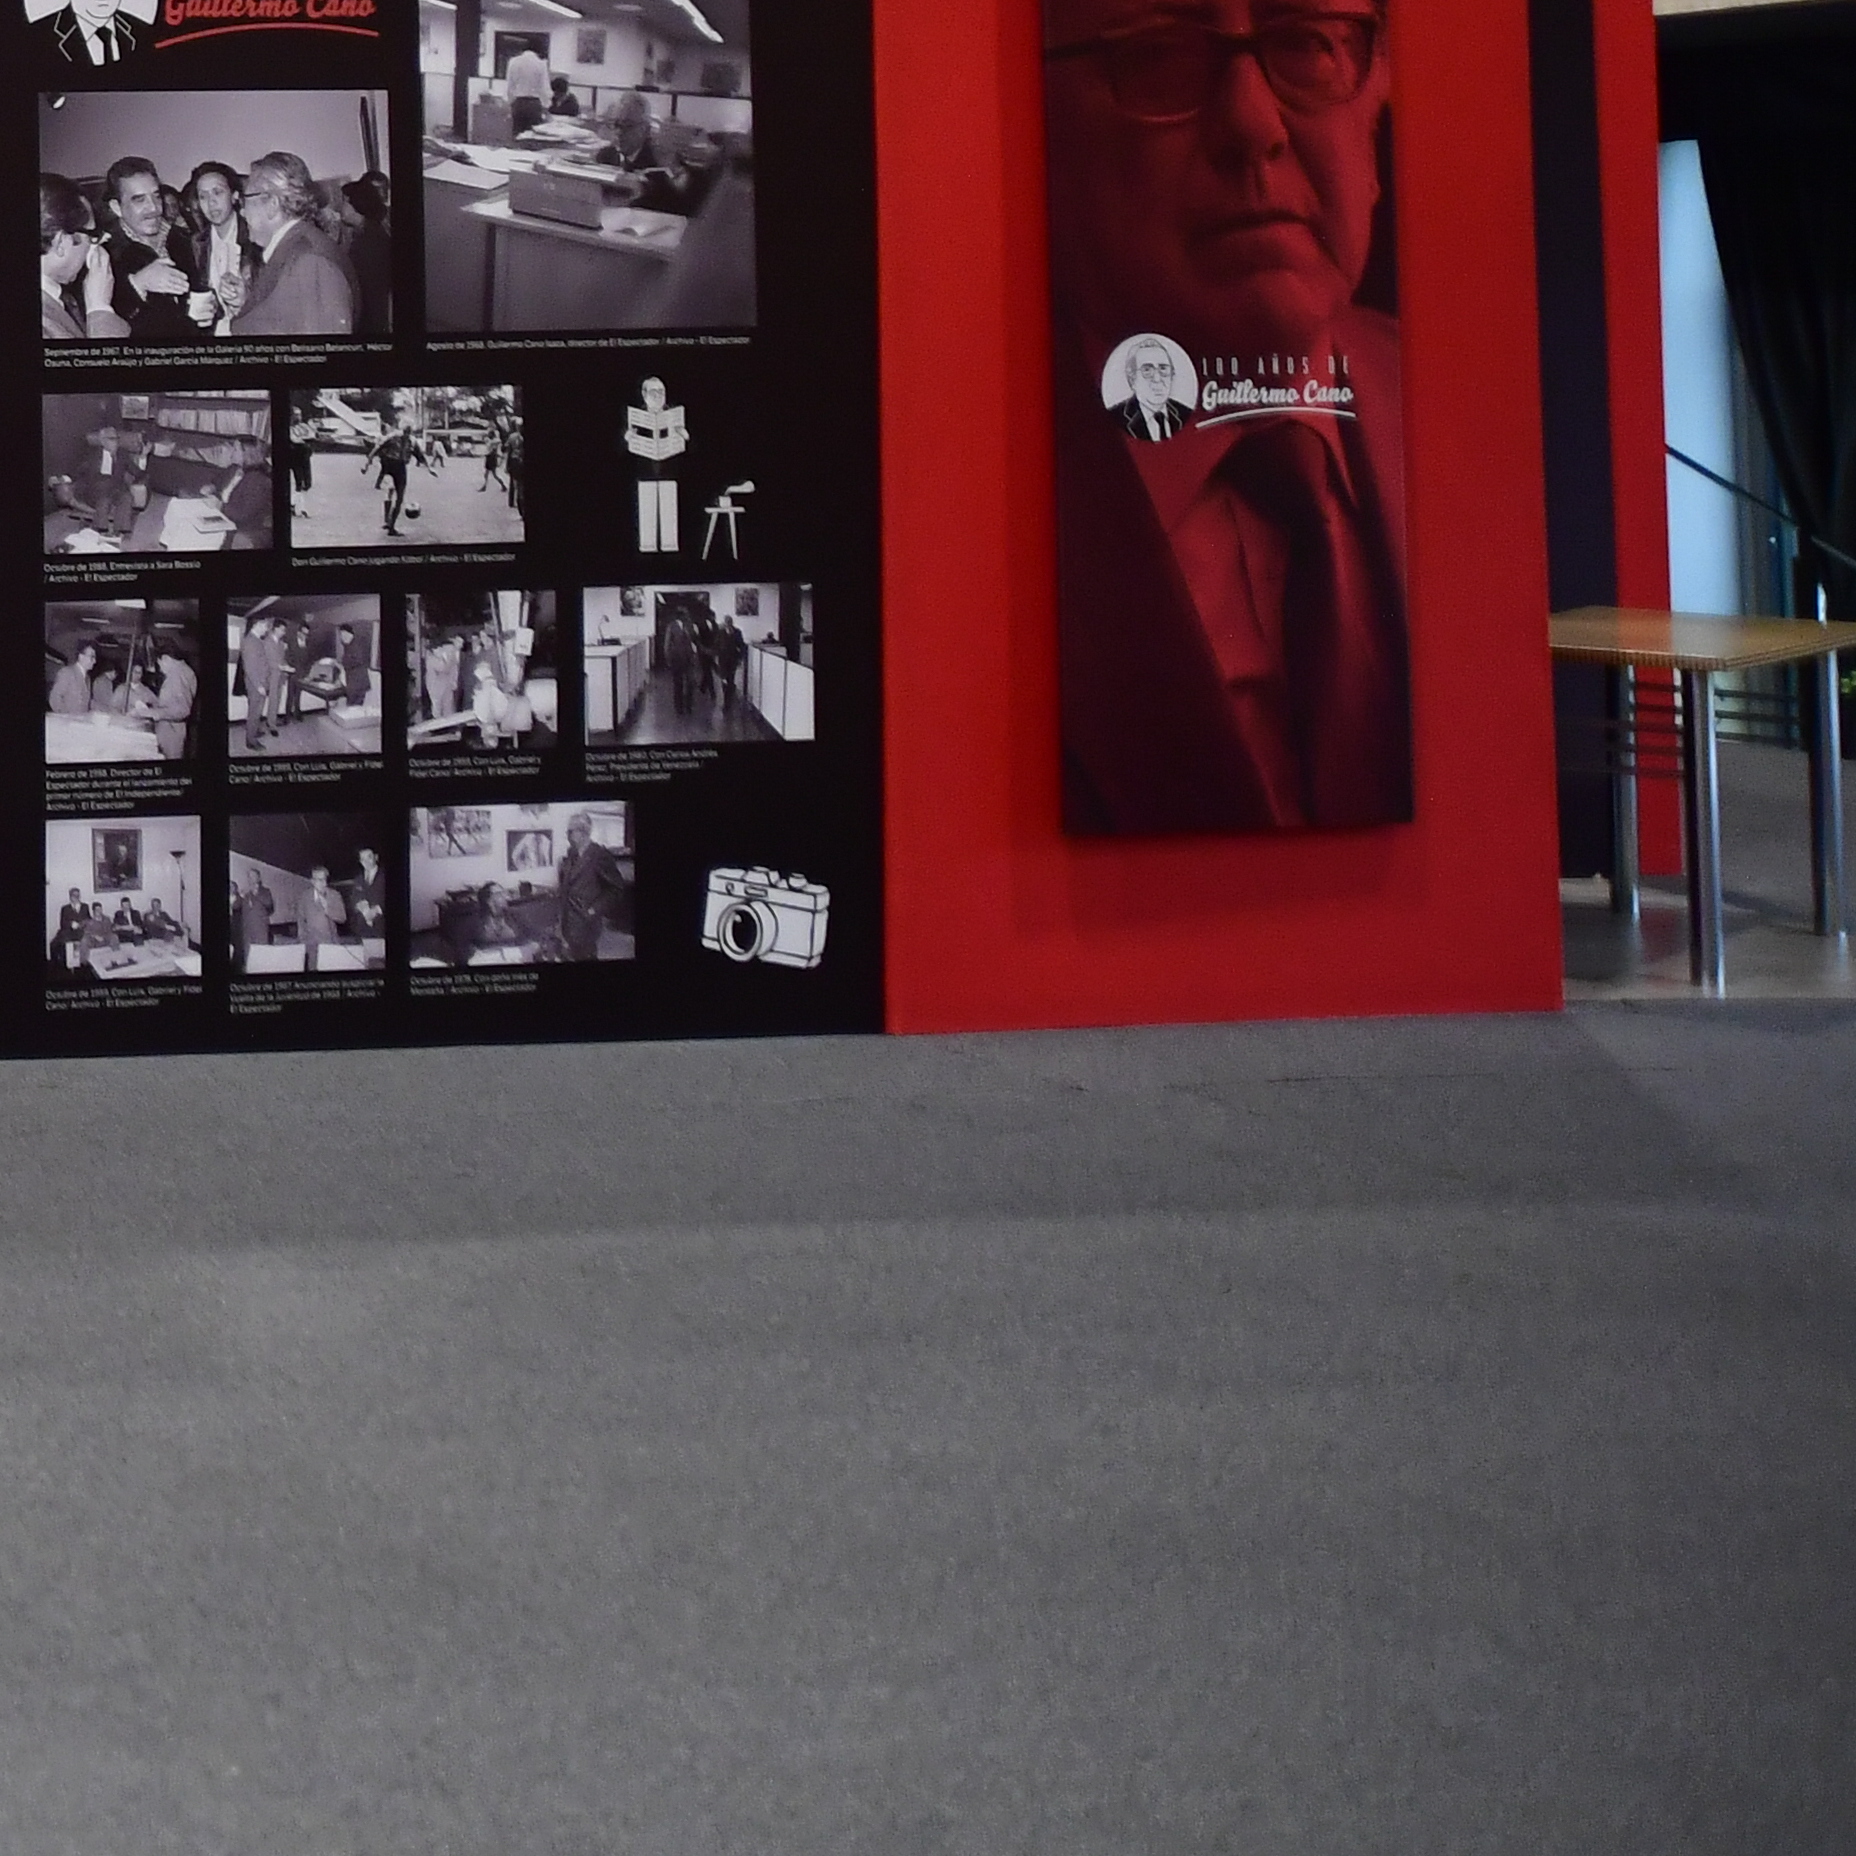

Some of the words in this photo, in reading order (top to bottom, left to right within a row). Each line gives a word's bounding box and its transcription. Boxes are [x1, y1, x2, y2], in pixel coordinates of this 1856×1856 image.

[1202, 357, 1239, 375] 100
[1258, 353, 1309, 375] AÑOS
[1328, 356, 1349, 374] DE
[1202, 378, 1300, 411] Guillermo
[1303, 380, 1354, 404] Cano
